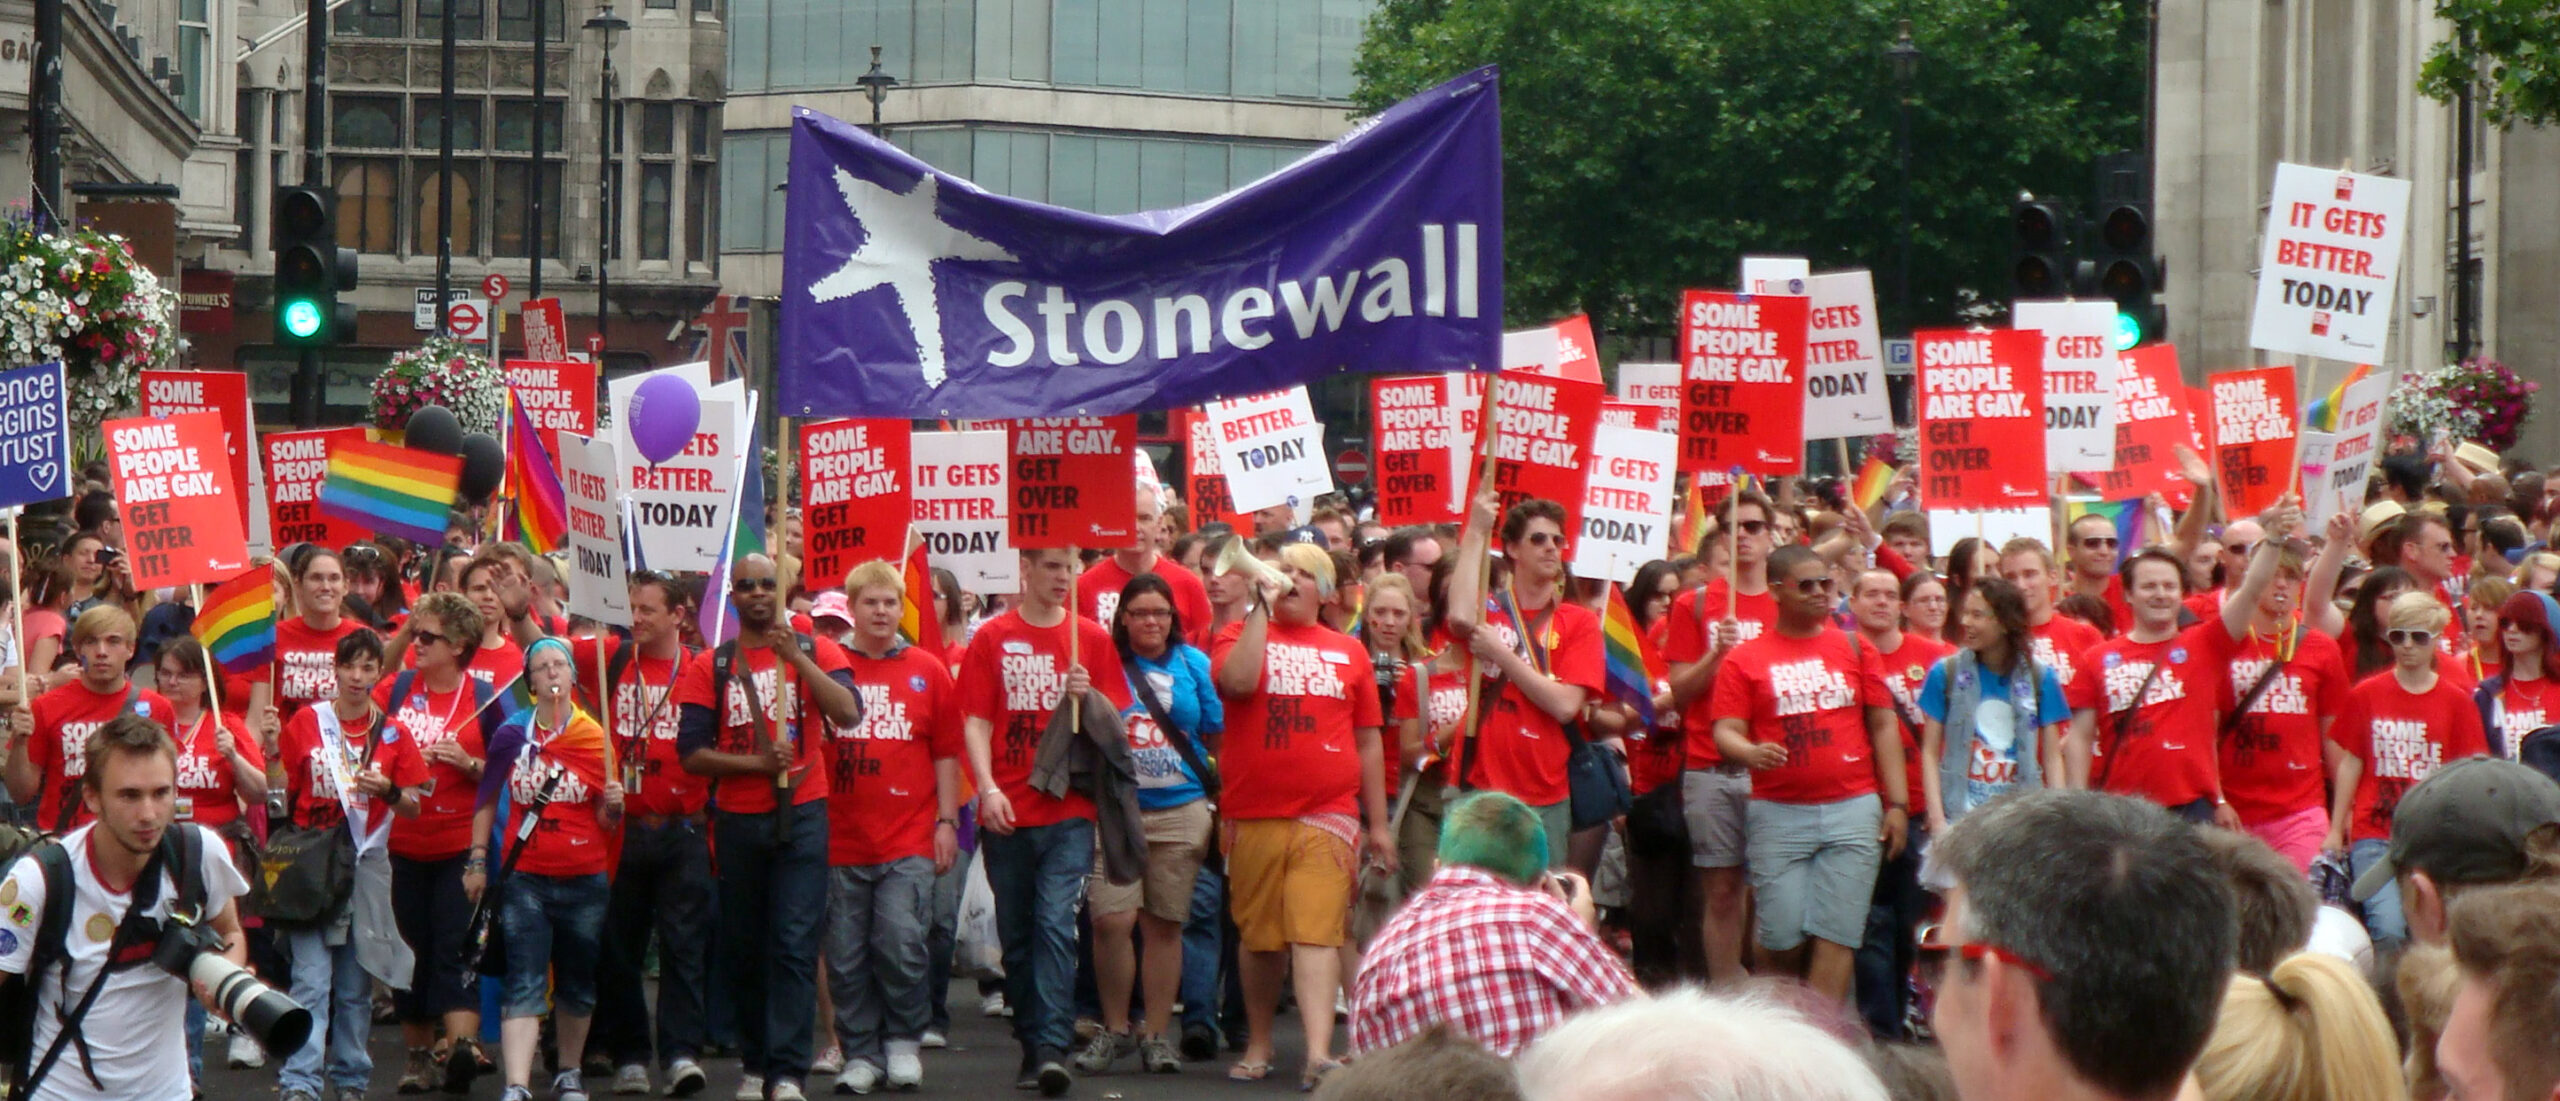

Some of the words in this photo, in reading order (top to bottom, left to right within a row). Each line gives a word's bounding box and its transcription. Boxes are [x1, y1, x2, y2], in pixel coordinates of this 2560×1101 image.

[2290, 202, 2316, 229] IT
[2324, 207, 2386, 239] GETS
[2277, 239, 2386, 280] BETTER...
[489, 276, 503, 297] S
[984, 222, 1480, 368] Stonewall
[2283, 279, 2373, 315] TODAY
[1691, 303, 1761, 329] SOME
[1812, 305, 1862, 330] GETS
[589, 338, 600, 351] T
[1691, 330, 1778, 356] PEOPLE
[1924, 341, 1992, 366] SOME
[2057, 336, 2103, 359] GETS
[511, 369, 559, 388] SOME
[1688, 358, 1737, 383] ARE
[1741, 359, 1793, 383] GAY.
[1924, 367, 2012, 393] PEOPLE
[148, 381, 204, 404] SOME
[1379, 385, 1435, 408] SOME
[1630, 385, 1643, 399] IT
[1689, 384, 1734, 408] GET
[1808, 372, 1868, 398] ODAY
[2214, 379, 2267, 402] SOME
[1926, 395, 1974, 419] ARE
[1976, 393, 2031, 418] GAY.
[2132, 398, 2177, 421] GAY.
[2215, 397, 2281, 425] PEOPLE
[545, 411, 584, 430] GAY.
[1222, 408, 1307, 443] BETTER...
[1381, 408, 1451, 429] PEOPLE
[1688, 412, 1750, 435] OVER
[113, 424, 178, 452] SOME
[808, 426, 867, 456] SOME
[1016, 430, 1063, 455] ARE
[1068, 429, 1122, 455] GAY.
[1382, 430, 1421, 451] ARE
[1928, 421, 1972, 445] GET
[2218, 424, 2254, 445] ARE
[2255, 418, 2294, 441] GAY.
[271, 438, 326, 461] SOME
[1531, 441, 1579, 469] GAY.
[1687, 438, 1717, 460] IT!
[1929, 447, 1992, 471] OVER
[118, 448, 200, 478] PEOPLE
[809, 448, 885, 480] PEOPLE
[1017, 459, 1060, 481] GET
[1385, 453, 1420, 472] GET
[1610, 457, 1659, 483] GETS
[569, 468, 579, 494] IT
[580, 474, 606, 502] GETS
[632, 466, 727, 493] BETTER...
[918, 465, 938, 487] IT
[946, 464, 1001, 486] GETS
[1387, 474, 1436, 493] OVER
[1931, 476, 1962, 497] IT!
[125, 478, 170, 504] ARE
[172, 472, 222, 498] GAY.
[275, 482, 312, 503] ARE
[810, 478, 851, 506] ARE
[854, 470, 900, 498] GAY.
[1017, 486, 1079, 509] OVER
[130, 502, 170, 527] GET
[277, 504, 312, 523] GET
[640, 502, 718, 528] TODAY
[811, 504, 849, 528] GET
[914, 498, 1008, 520] BETTER...
[1387, 497, 1412, 516] IT!
[279, 523, 328, 543] OVER
[570, 507, 614, 542] BETTER...
[1017, 514, 1048, 536] IT!
[1581, 517, 1652, 545] TODAY
[135, 526, 194, 550] OVER
[812, 527, 866, 553] OVER
[923, 531, 1000, 554] TODAY
[140, 554, 170, 578] IT!
[577, 545, 612, 579] TODAY
[813, 555, 839, 578] IT!
[284, 652, 334, 666] SOME
[1267, 643, 1318, 662] SOME
[1002, 655, 1055, 674] SOME
[1267, 660, 1337, 680] PEOPLE
[1770, 660, 1825, 681] SOME
[281, 682, 315, 699] ARE
[1267, 677, 1306, 696] ARE
[1308, 678, 1345, 700] GAY.
[1772, 672, 1848, 698] PEOPLE
[1007, 692, 1040, 712] ARE
[1268, 698, 1303, 714] GET
[1777, 693, 1817, 716] ARE
[1818, 688, 1855, 710] GAY.
[874, 722, 912, 740] GAY.
[1267, 715, 1316, 734] OVER
[2372, 719, 2427, 738] SOME
[2373, 736, 2442, 762] PEOPLE
[2376, 758, 2410, 778] ARE
